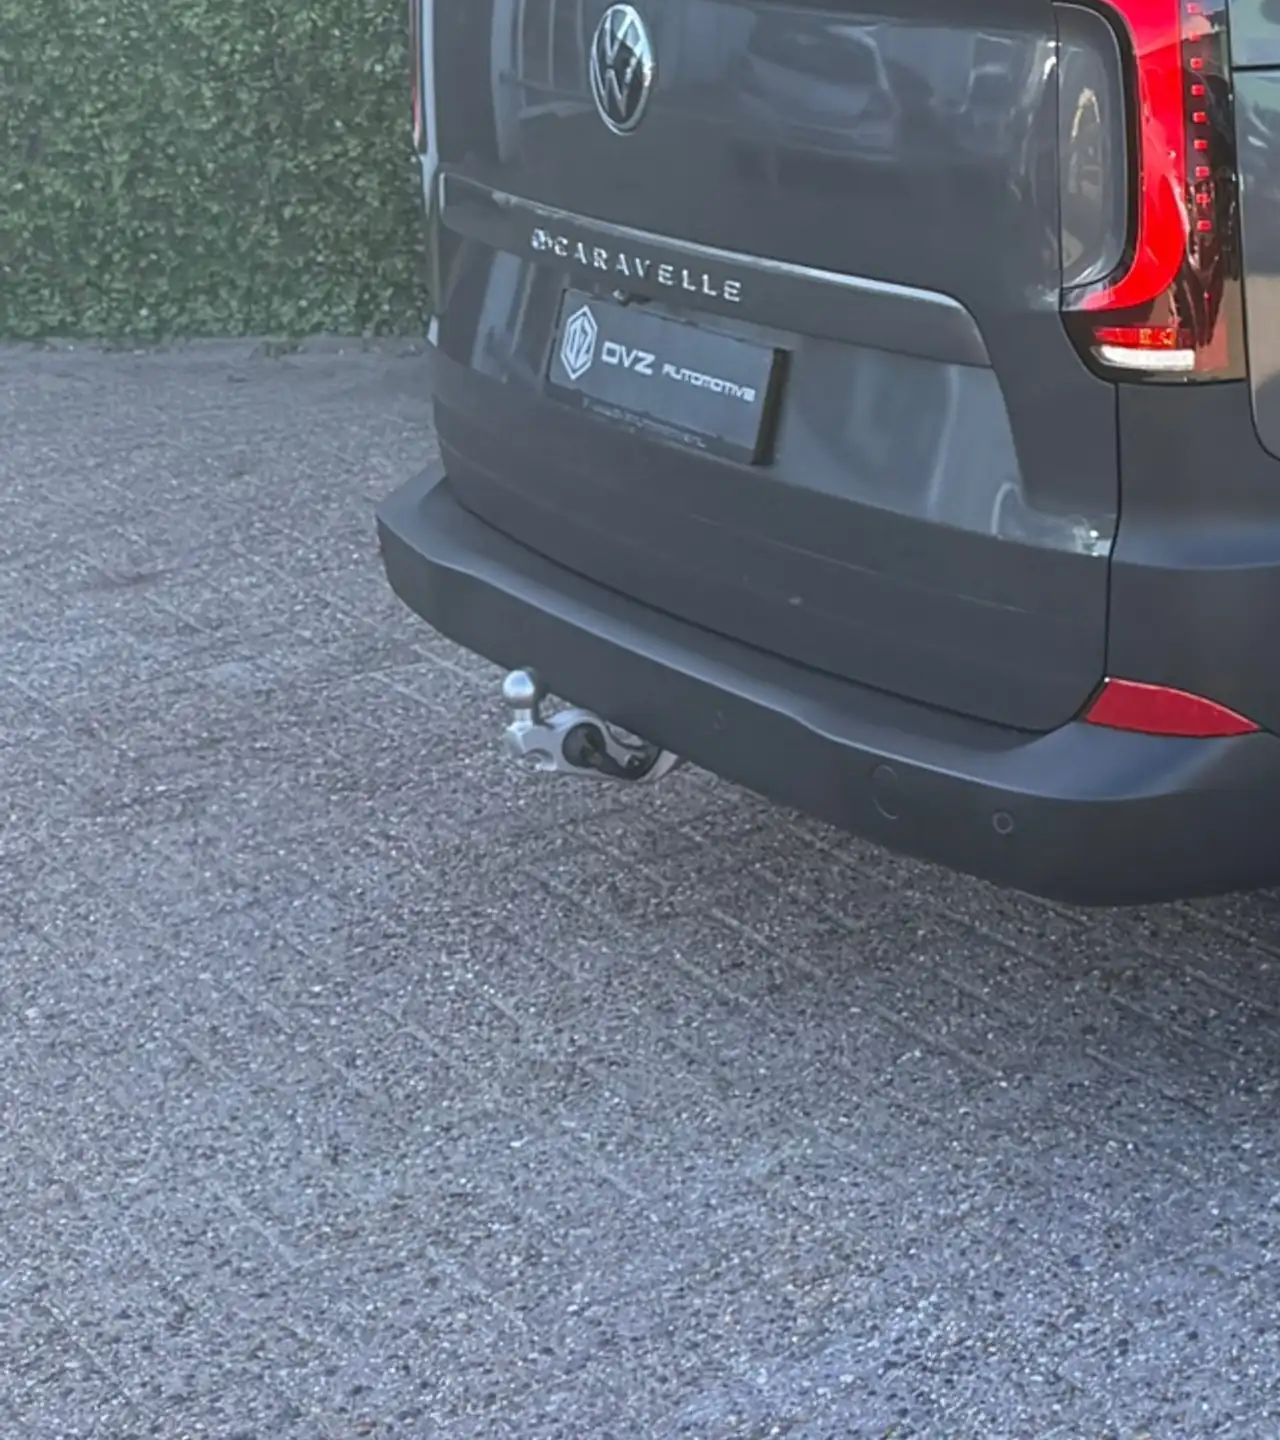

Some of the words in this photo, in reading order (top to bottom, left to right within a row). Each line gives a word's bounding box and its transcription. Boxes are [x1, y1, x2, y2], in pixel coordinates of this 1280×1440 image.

[553, 235, 742, 303] CARAVELLE
[601, 340, 656, 376] DVZ
[661, 362, 756, 403] AUTOMOTIVE
